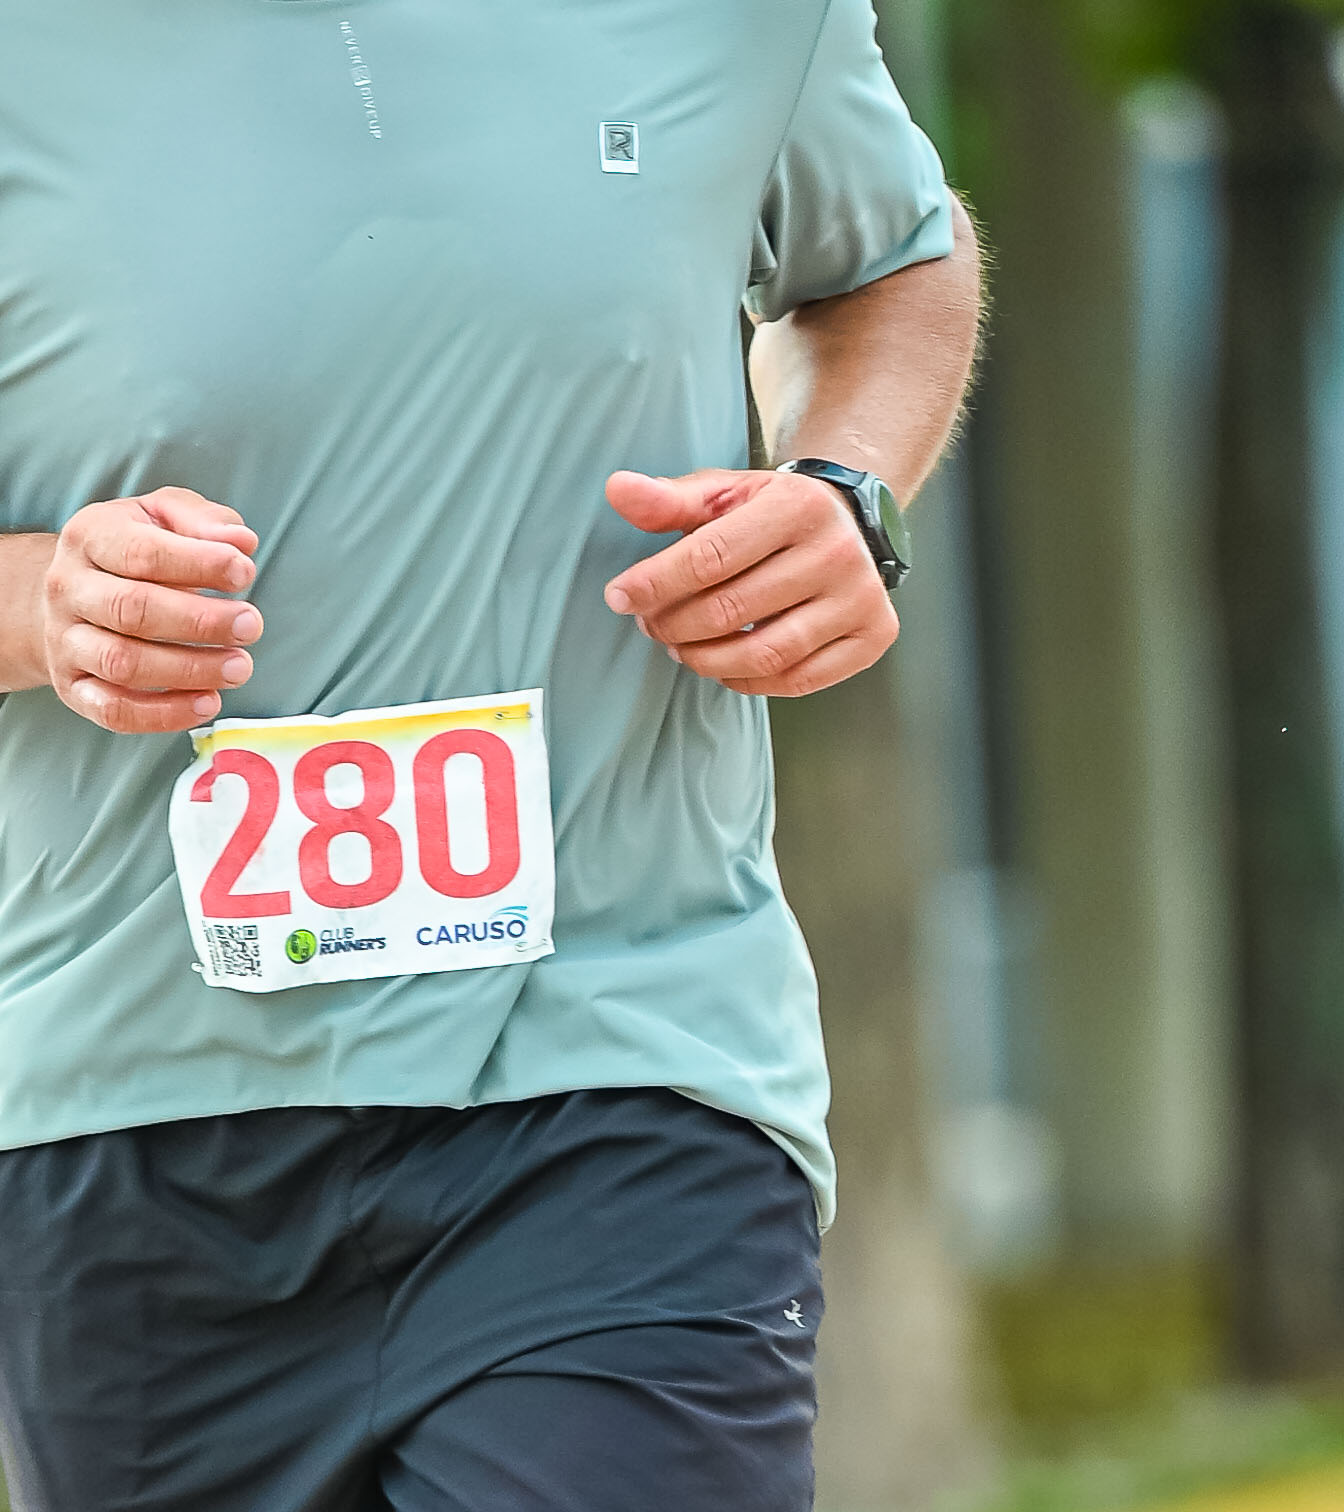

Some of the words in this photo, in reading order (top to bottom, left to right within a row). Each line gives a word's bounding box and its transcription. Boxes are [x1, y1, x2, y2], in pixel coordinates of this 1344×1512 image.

[190, 729, 521, 918] 280
[320, 927, 355, 942] CLUB
[415, 919, 526, 946] CARUSO
[319, 937, 387, 956] RUNNER'S
